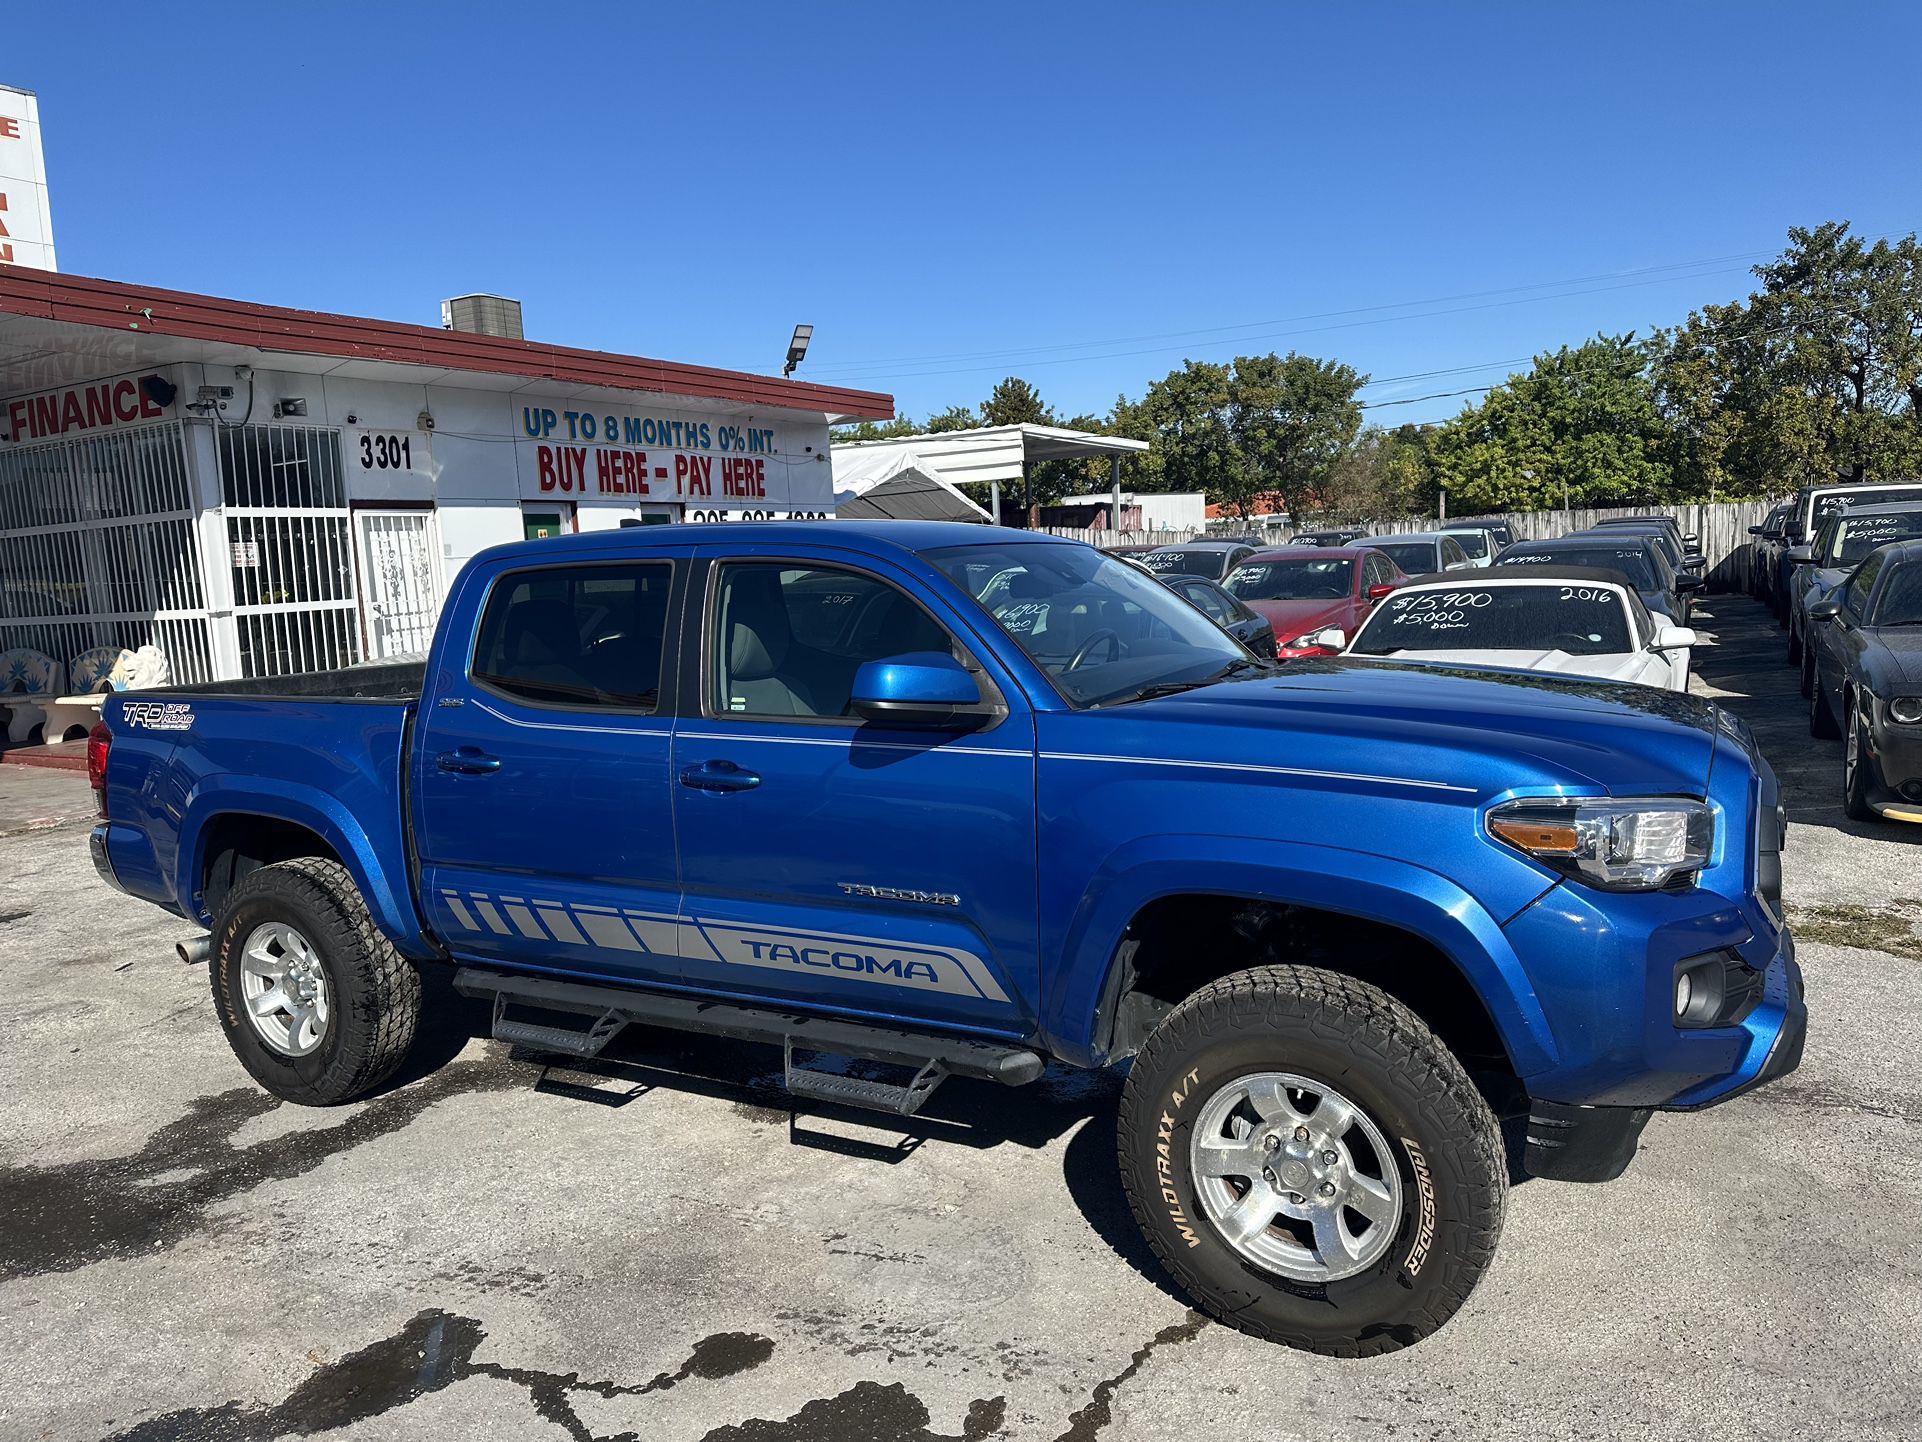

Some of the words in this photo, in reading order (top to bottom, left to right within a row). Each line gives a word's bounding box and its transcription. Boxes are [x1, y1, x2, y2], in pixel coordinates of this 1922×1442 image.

[9, 373, 162, 443] FINANCE
[523, 407, 557, 437] UP
[564, 411, 597, 440] TO
[605, 416, 619, 441] 8
[624, 416, 711, 449] MONTHS
[718, 426, 745, 452] 0%
[748, 428, 777, 453] INT.
[360, 435, 412, 470] 3301
[537, 446, 587, 493] BUY
[596, 448, 649, 495] HERE
[675, 454, 712, 497] PAY
[721, 457, 766, 498] HERE
[1616, 550, 1643, 559] 2014
[821, 594, 854, 605] 2017
[1392, 592, 1493, 612] $15,900
[1561, 586, 1612, 603] 2016
[1394, 610, 1465, 626] $5,000
[123, 702, 165, 728] TRD
[165, 704, 190, 714] OFF
[161, 713, 195, 724] ROAD
[837, 881, 961, 906] TACOMA
[740, 940, 939, 983] TACOMA
[1171, 1066, 1200, 1109] A/T
[1156, 1109, 1201, 1249] WILDTRAXX
[1401, 1136, 1436, 1277] LANDSPIDER
